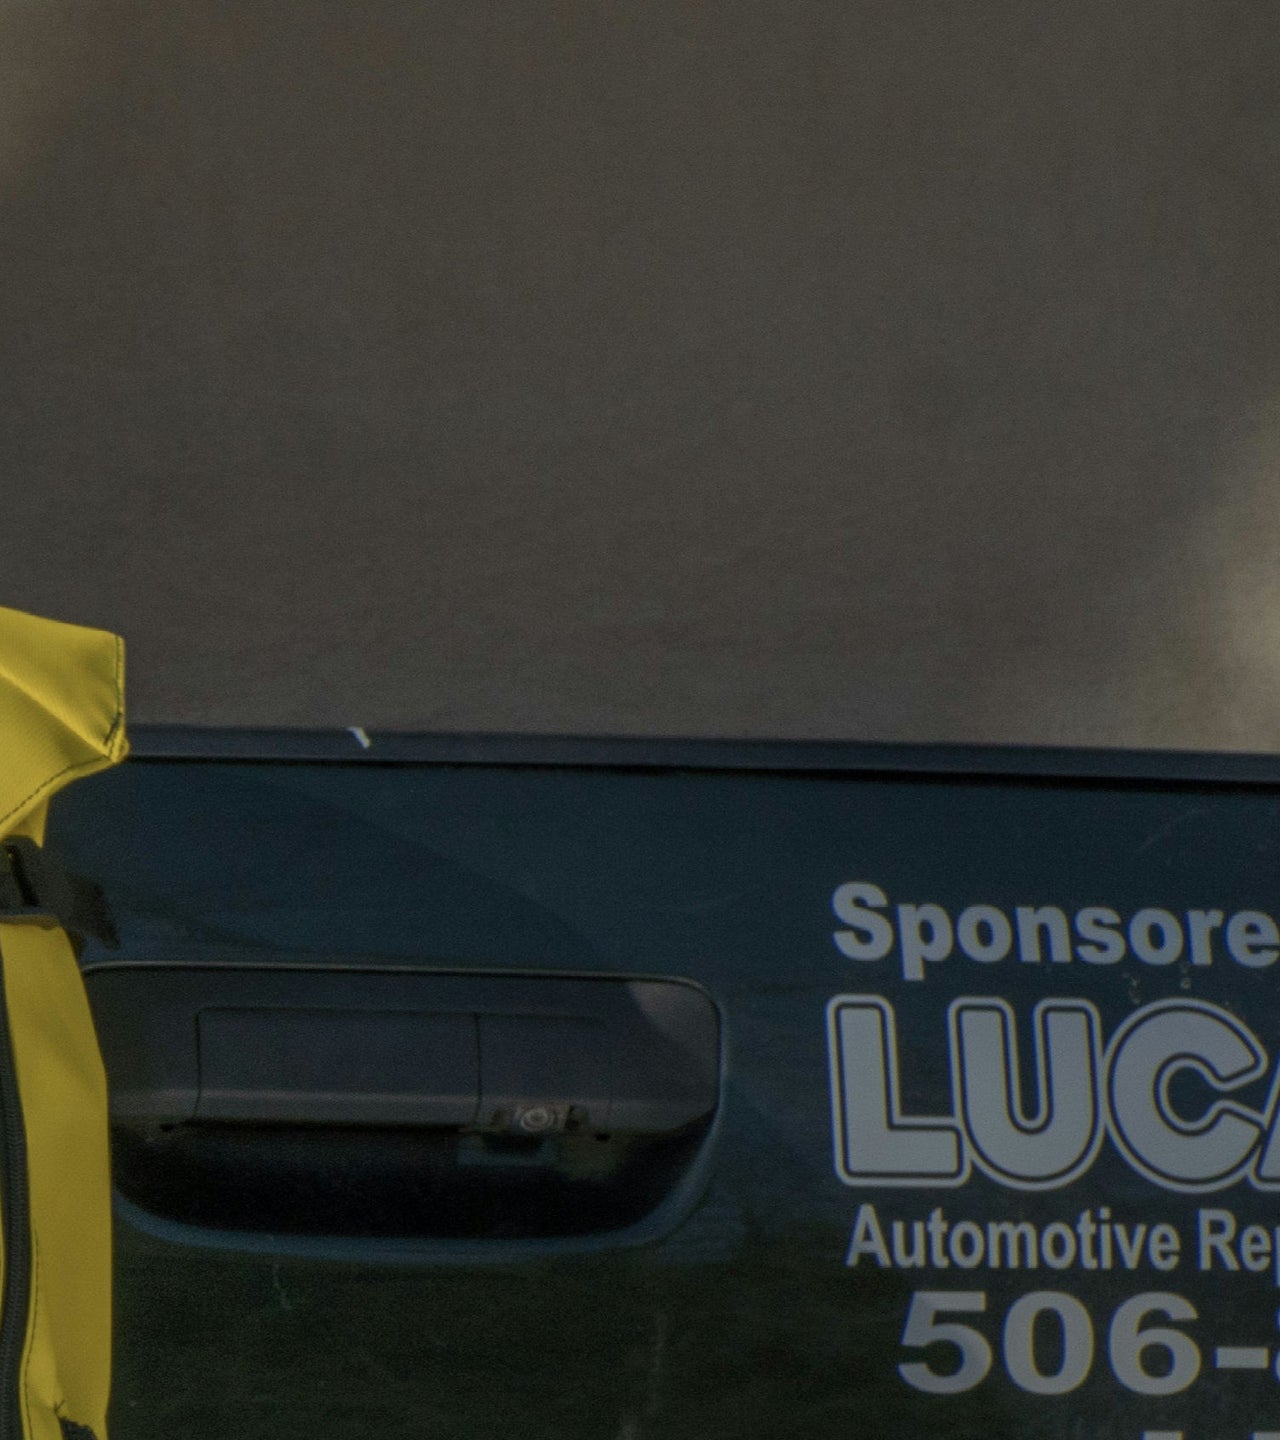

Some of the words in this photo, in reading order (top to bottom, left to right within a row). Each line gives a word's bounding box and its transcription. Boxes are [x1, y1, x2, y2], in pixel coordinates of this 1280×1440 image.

[832, 881, 1280, 981] Sponsore
[846, 1203, 1181, 1270] Automotive
[1197, 1208, 1280, 1287] Re
[897, 1290, 1280, 1395] 506-
